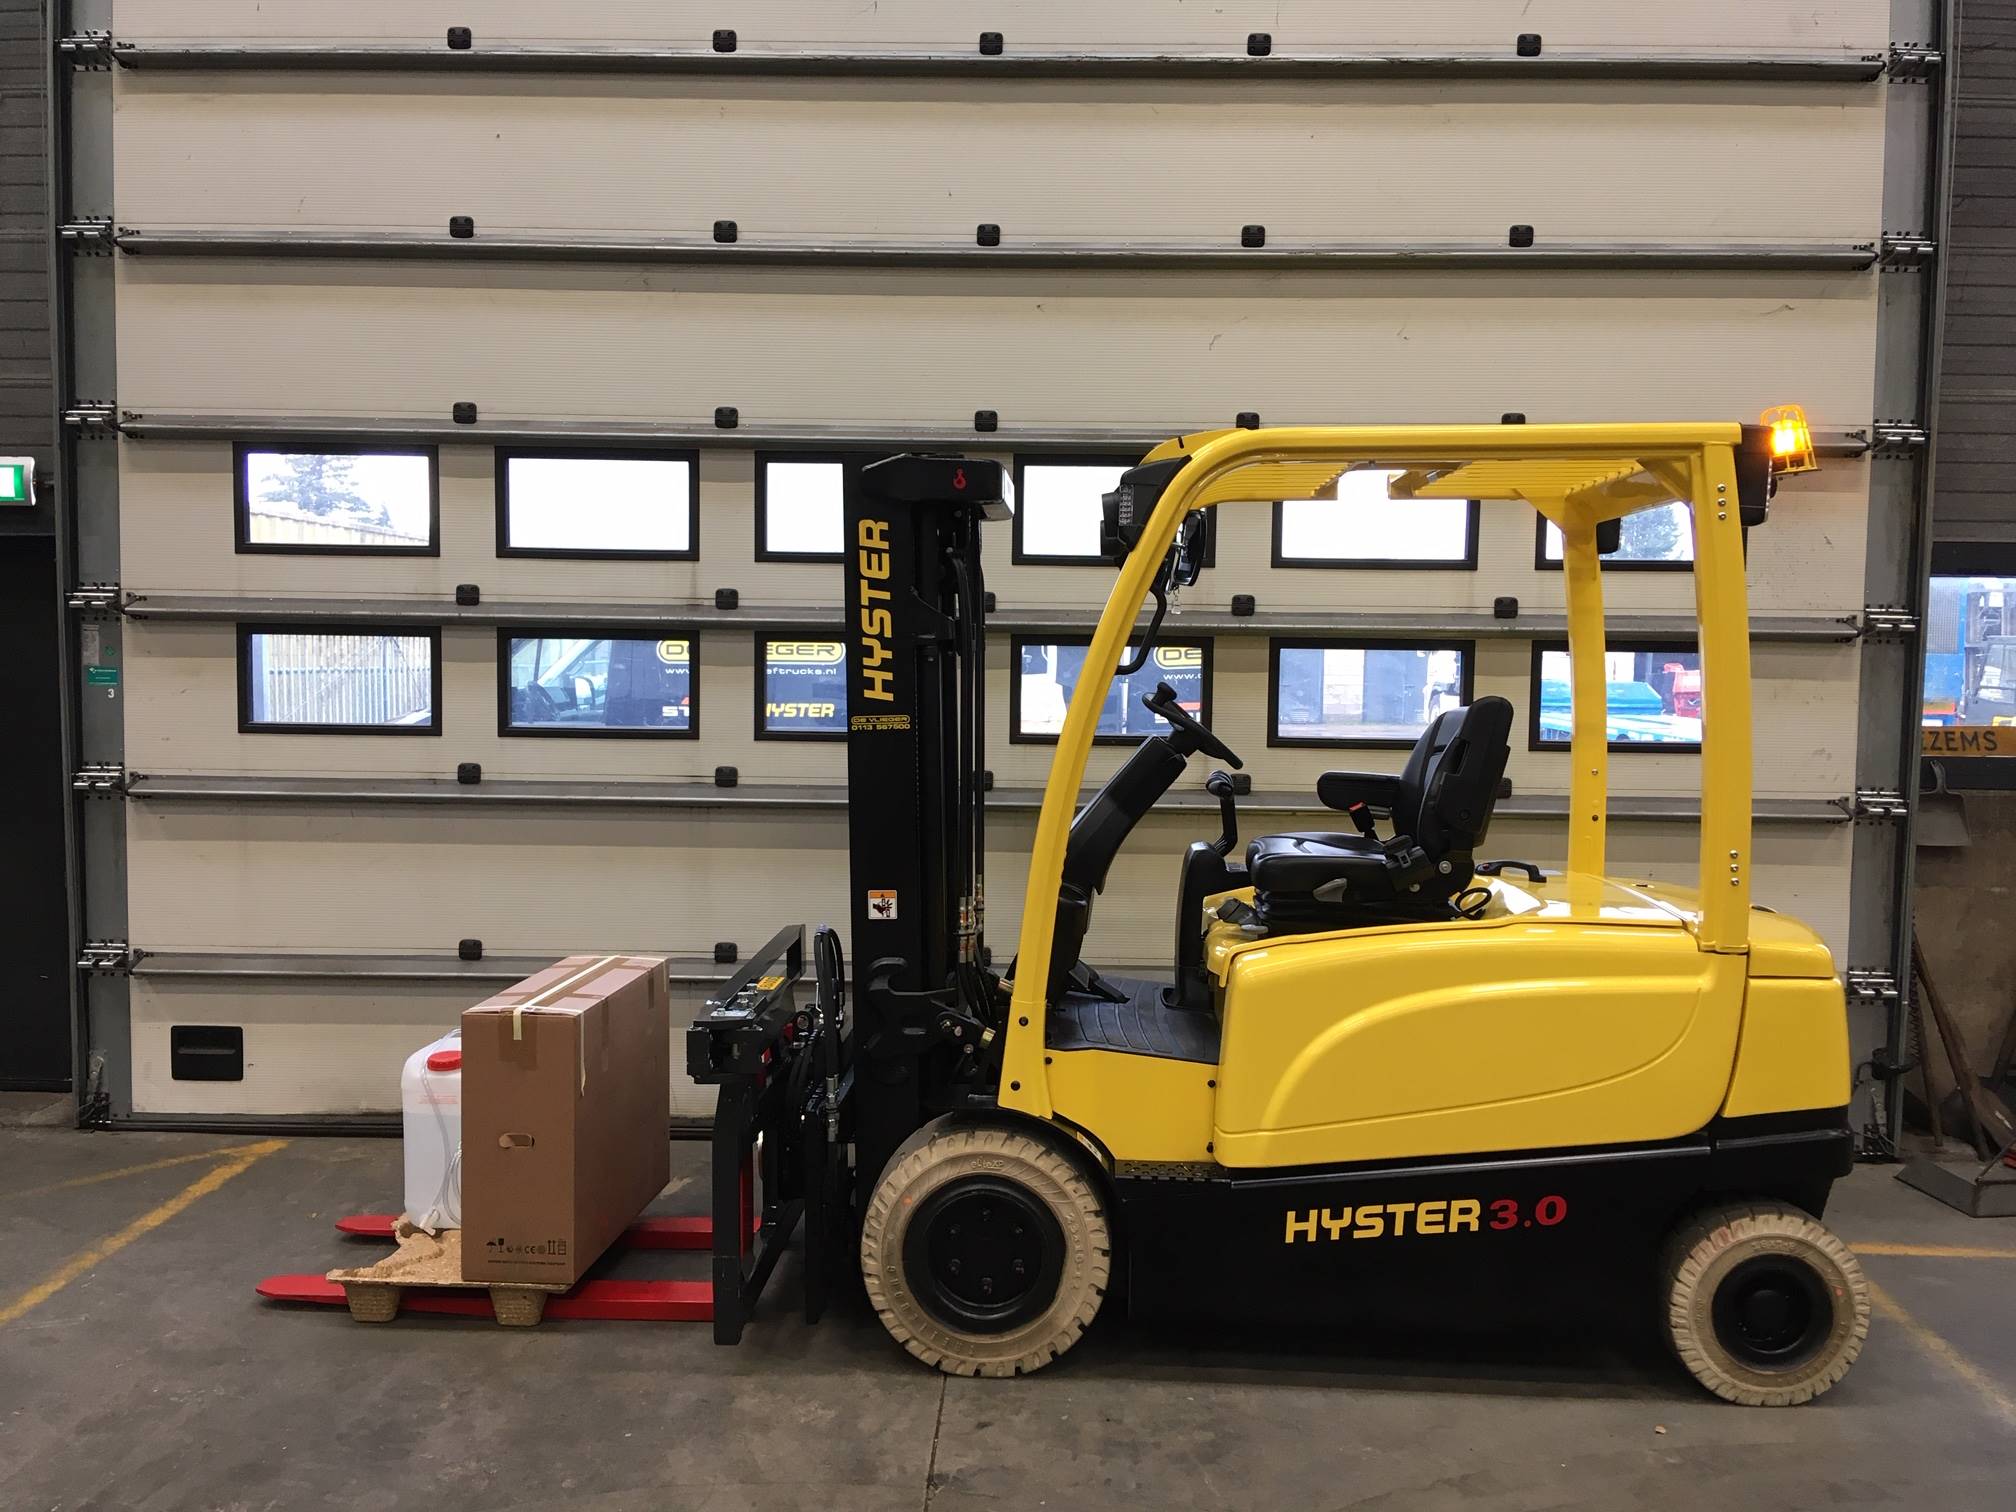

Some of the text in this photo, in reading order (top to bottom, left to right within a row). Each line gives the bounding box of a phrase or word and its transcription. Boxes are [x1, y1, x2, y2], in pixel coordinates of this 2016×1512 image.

[858, 519, 895, 702] HYSTER
[107, 688, 115, 698] 3
[1284, 1195, 1568, 1244] HYSTER 3.0
